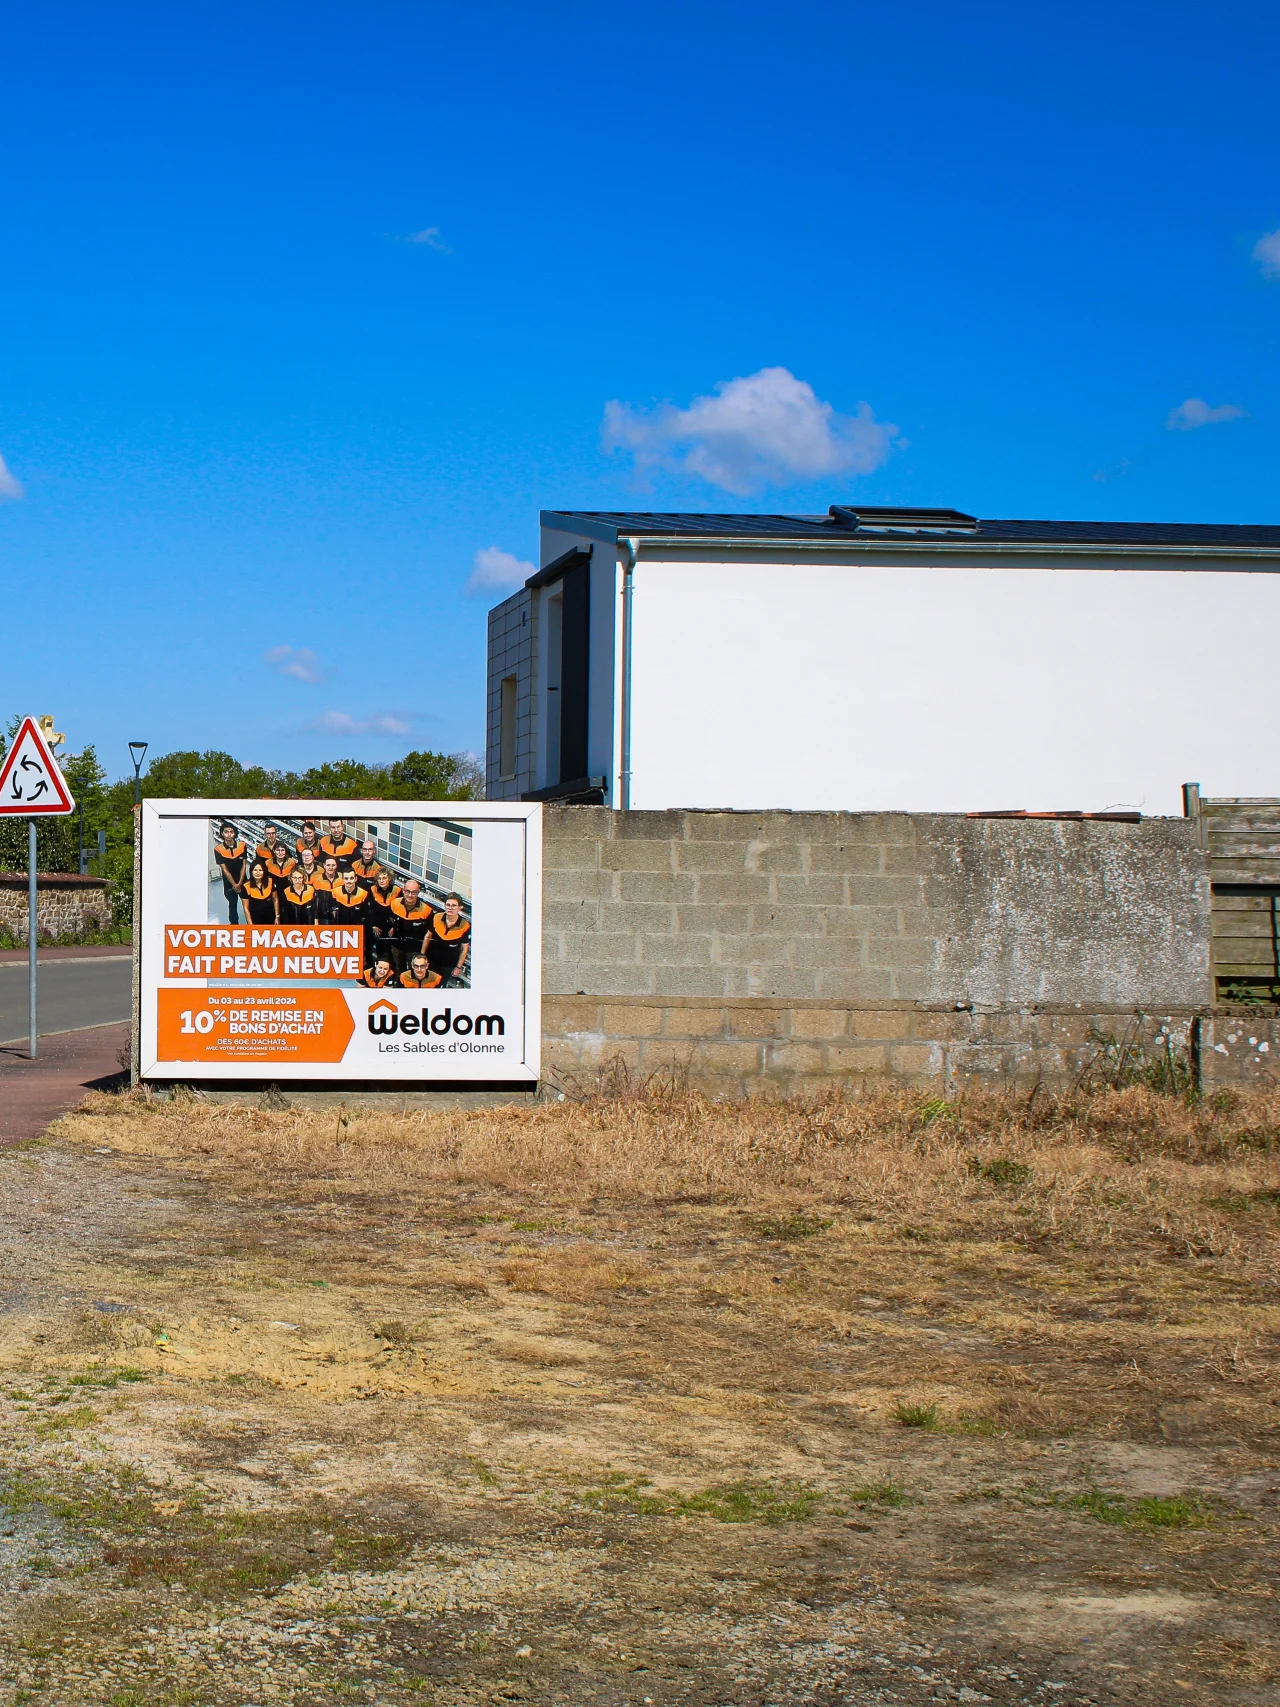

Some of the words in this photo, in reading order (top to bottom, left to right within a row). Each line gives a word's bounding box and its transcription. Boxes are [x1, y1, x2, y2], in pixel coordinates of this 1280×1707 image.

[168, 929, 245, 948] VOTRE
[252, 930, 359, 949] MAGASIN
[168, 956, 215, 974] FAIT
[220, 956, 278, 974] PEAU
[284, 956, 360, 974] NEUVE
[208, 997, 220, 1005] Du
[221, 997, 232, 1005] 03
[245, 997, 255, 1005] 23
[256, 997, 275, 1005] avril
[275, 997, 297, 1005] 2024
[180, 1009, 227, 1034] 10%
[229, 1010, 249, 1022] DE
[251, 1010, 303, 1022] REMISE
[305, 1010, 324, 1022] EN
[229, 1022, 266, 1034] BONS
[269, 1022, 324, 1034] D'ACHAT
[378, 1041, 400, 1053] Les
[403, 1041, 445, 1053] Sables
[448, 1041, 506, 1053] d'Olonne
